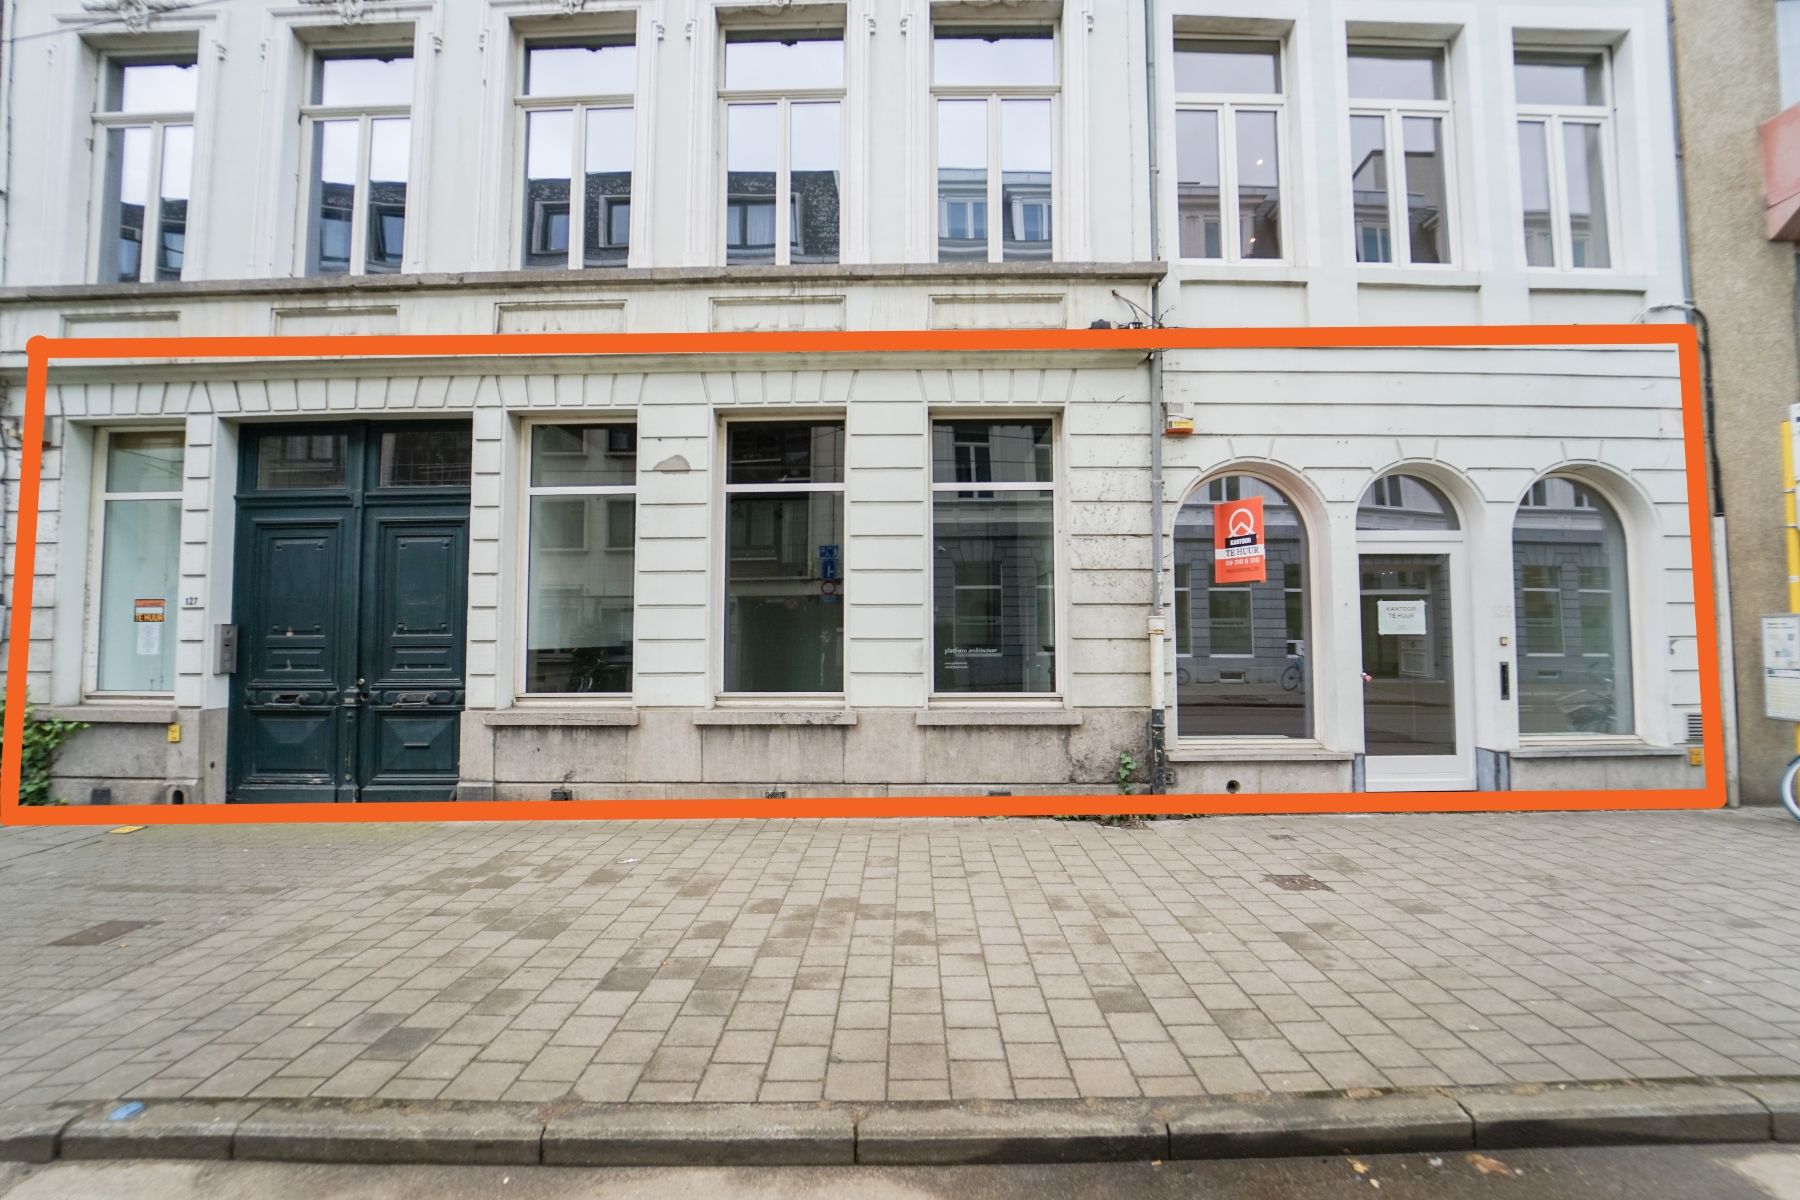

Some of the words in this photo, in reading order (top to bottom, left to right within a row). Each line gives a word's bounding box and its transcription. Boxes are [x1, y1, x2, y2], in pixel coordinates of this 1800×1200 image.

[1236, 546, 1260, 556] HUUR
[185, 596, 198, 606] 127
[144, 613, 164, 622] HUUR
